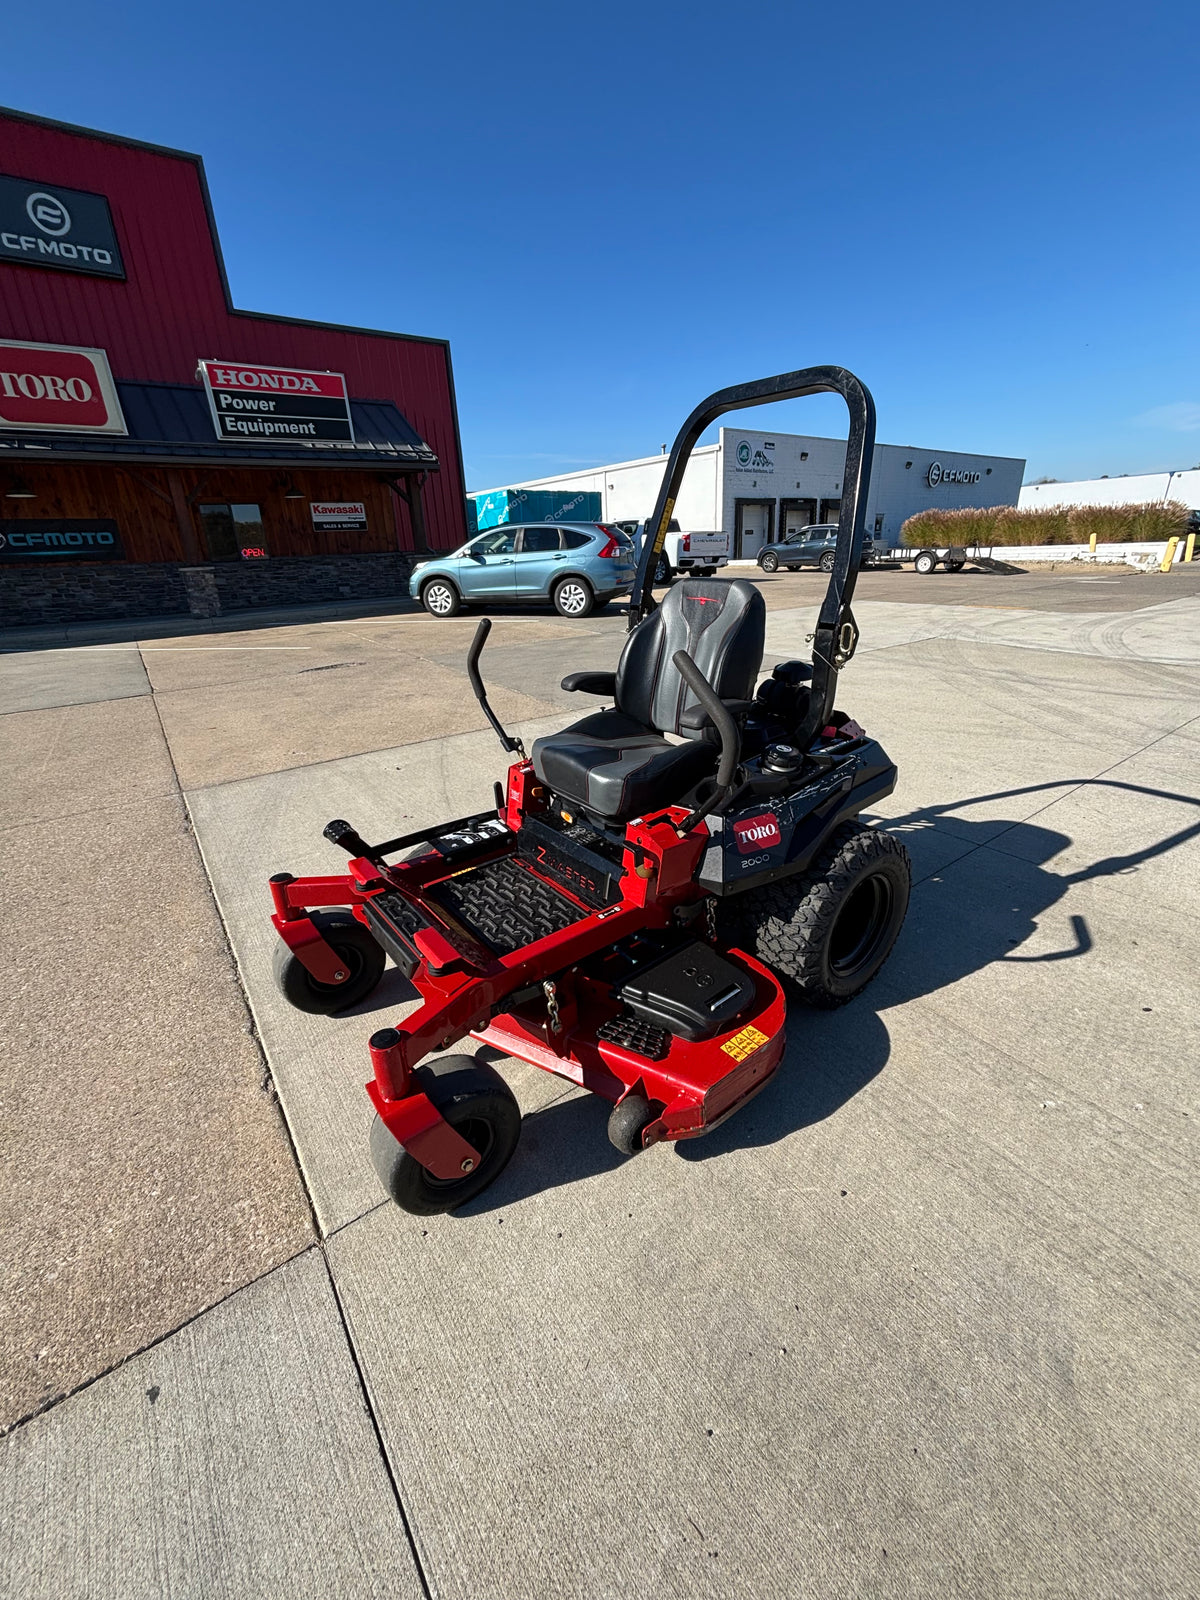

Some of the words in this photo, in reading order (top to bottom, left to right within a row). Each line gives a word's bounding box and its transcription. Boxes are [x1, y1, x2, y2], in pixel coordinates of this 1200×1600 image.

[1, 232, 112, 264] CFMOTO
[0, 372, 92, 402] TORO
[213, 368, 322, 392] HONDA
[219, 394, 276, 411] Power
[224, 416, 317, 435] Equipment
[942, 469, 981, 483] CFMOTO
[312, 504, 364, 514] Kawasaki
[8, 532, 114, 547] CFMOTO
[241, 548, 265, 558] OPEN
[738, 823, 776, 843] TORO
[741, 854, 770, 868] 2000
